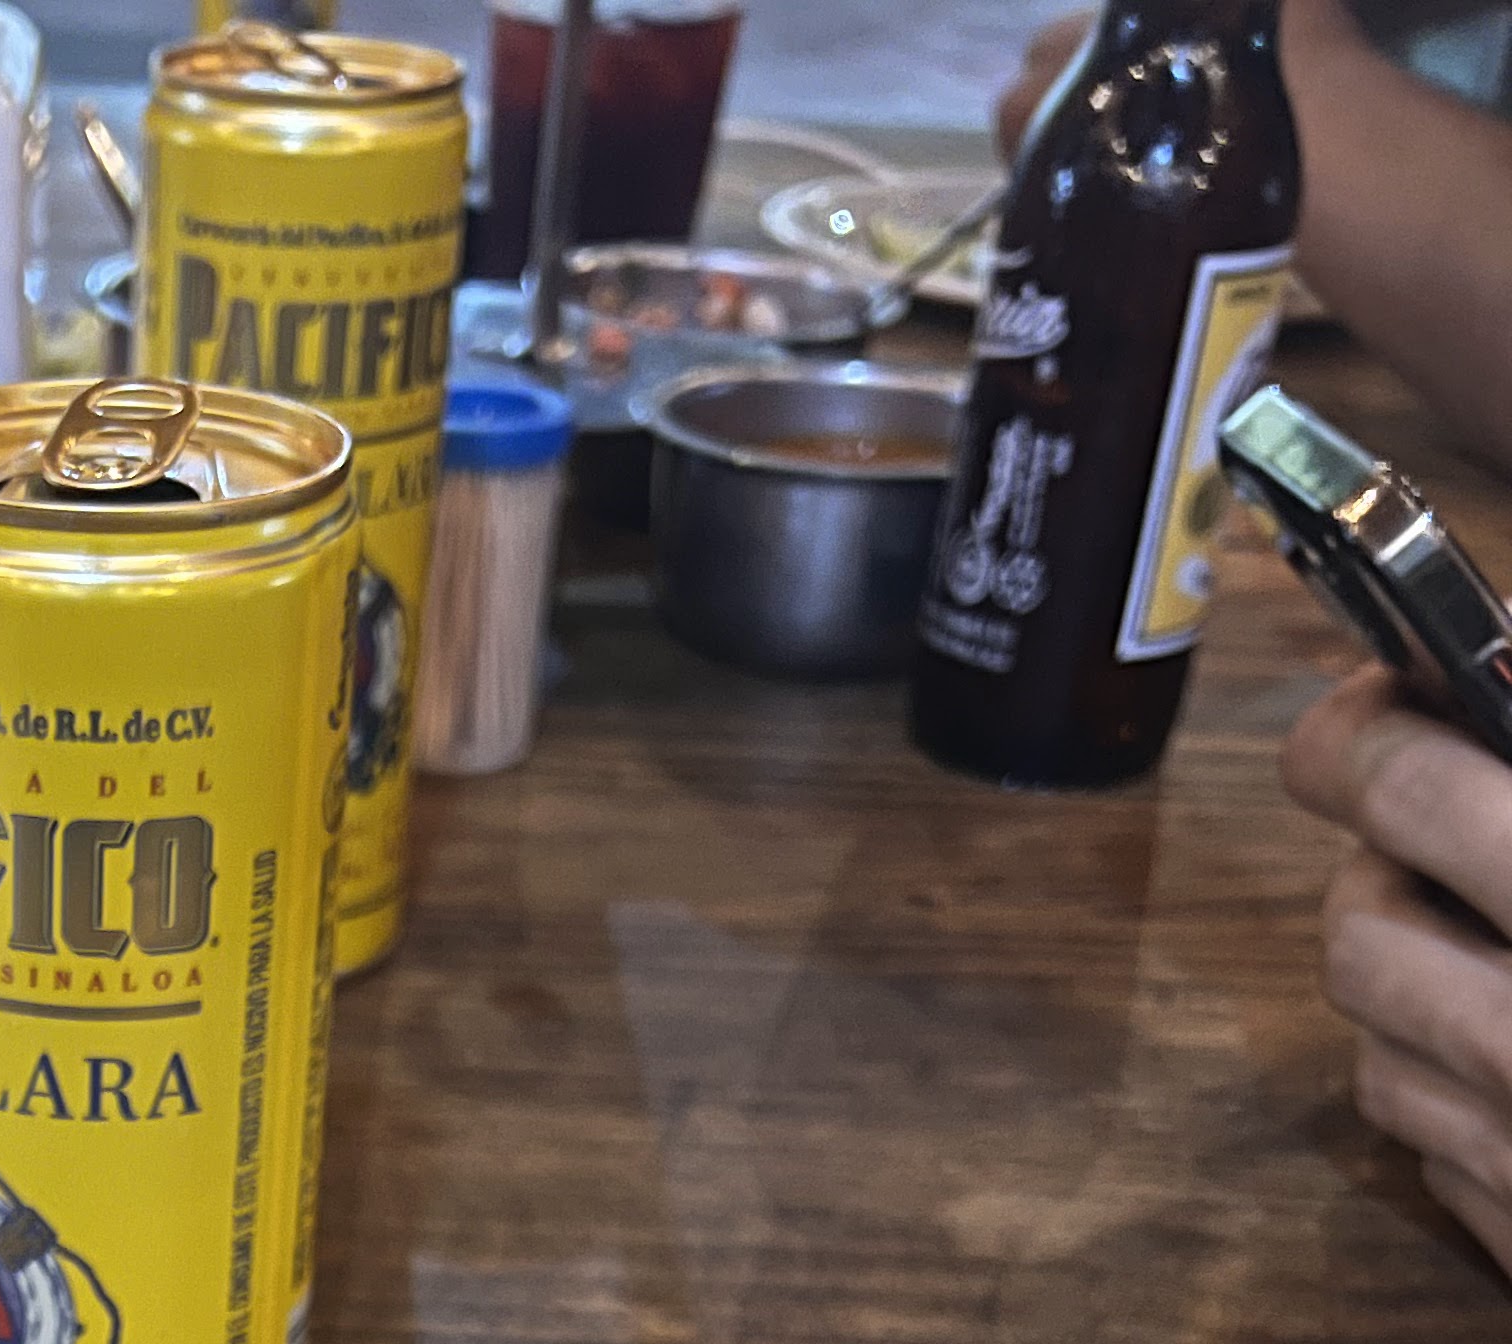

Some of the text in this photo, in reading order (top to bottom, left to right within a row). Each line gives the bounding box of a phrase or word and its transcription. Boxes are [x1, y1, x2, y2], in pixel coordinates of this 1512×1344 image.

[13, 704, 49, 739] de
[54, 708, 118, 743] R.L.
[123, 709, 161, 743] de
[97, 767, 214, 798] DEL
[0, 965, 203, 994] SINALOA
